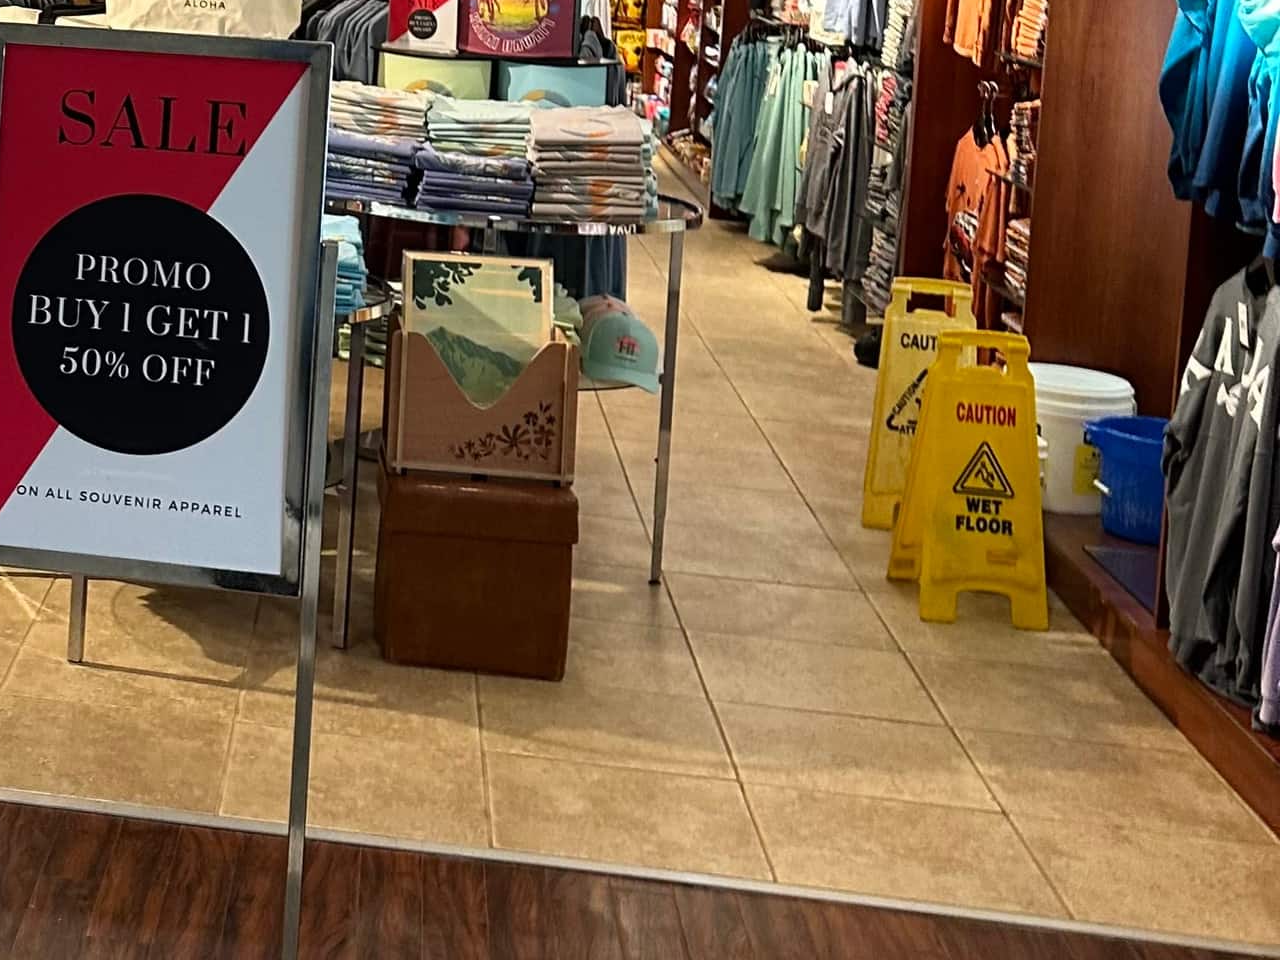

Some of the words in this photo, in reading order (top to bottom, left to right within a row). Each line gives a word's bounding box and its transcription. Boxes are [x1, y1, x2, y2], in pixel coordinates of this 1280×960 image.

[184, 0, 226, 10] ALOHA
[58, 88, 248, 157] SALE
[74, 253, 211, 292] PROMO
[27, 294, 110, 330] BUY
[120, 302, 131, 333] 1
[146, 304, 229, 341] GET
[240, 312, 251, 344] 1
[900, 332, 937, 352] CAUT
[59, 345, 129, 379] 50%
[142, 353, 216, 386] OFF
[956, 402, 1017, 427] CAUTION
[16, 484, 39, 497] ON
[45, 487, 73, 500] ALL
[79, 490, 162, 509] SOUVENIR
[168, 500, 242, 518] APPAREL
[966, 497, 1003, 515] WET
[955, 515, 1013, 536] FLOOR
